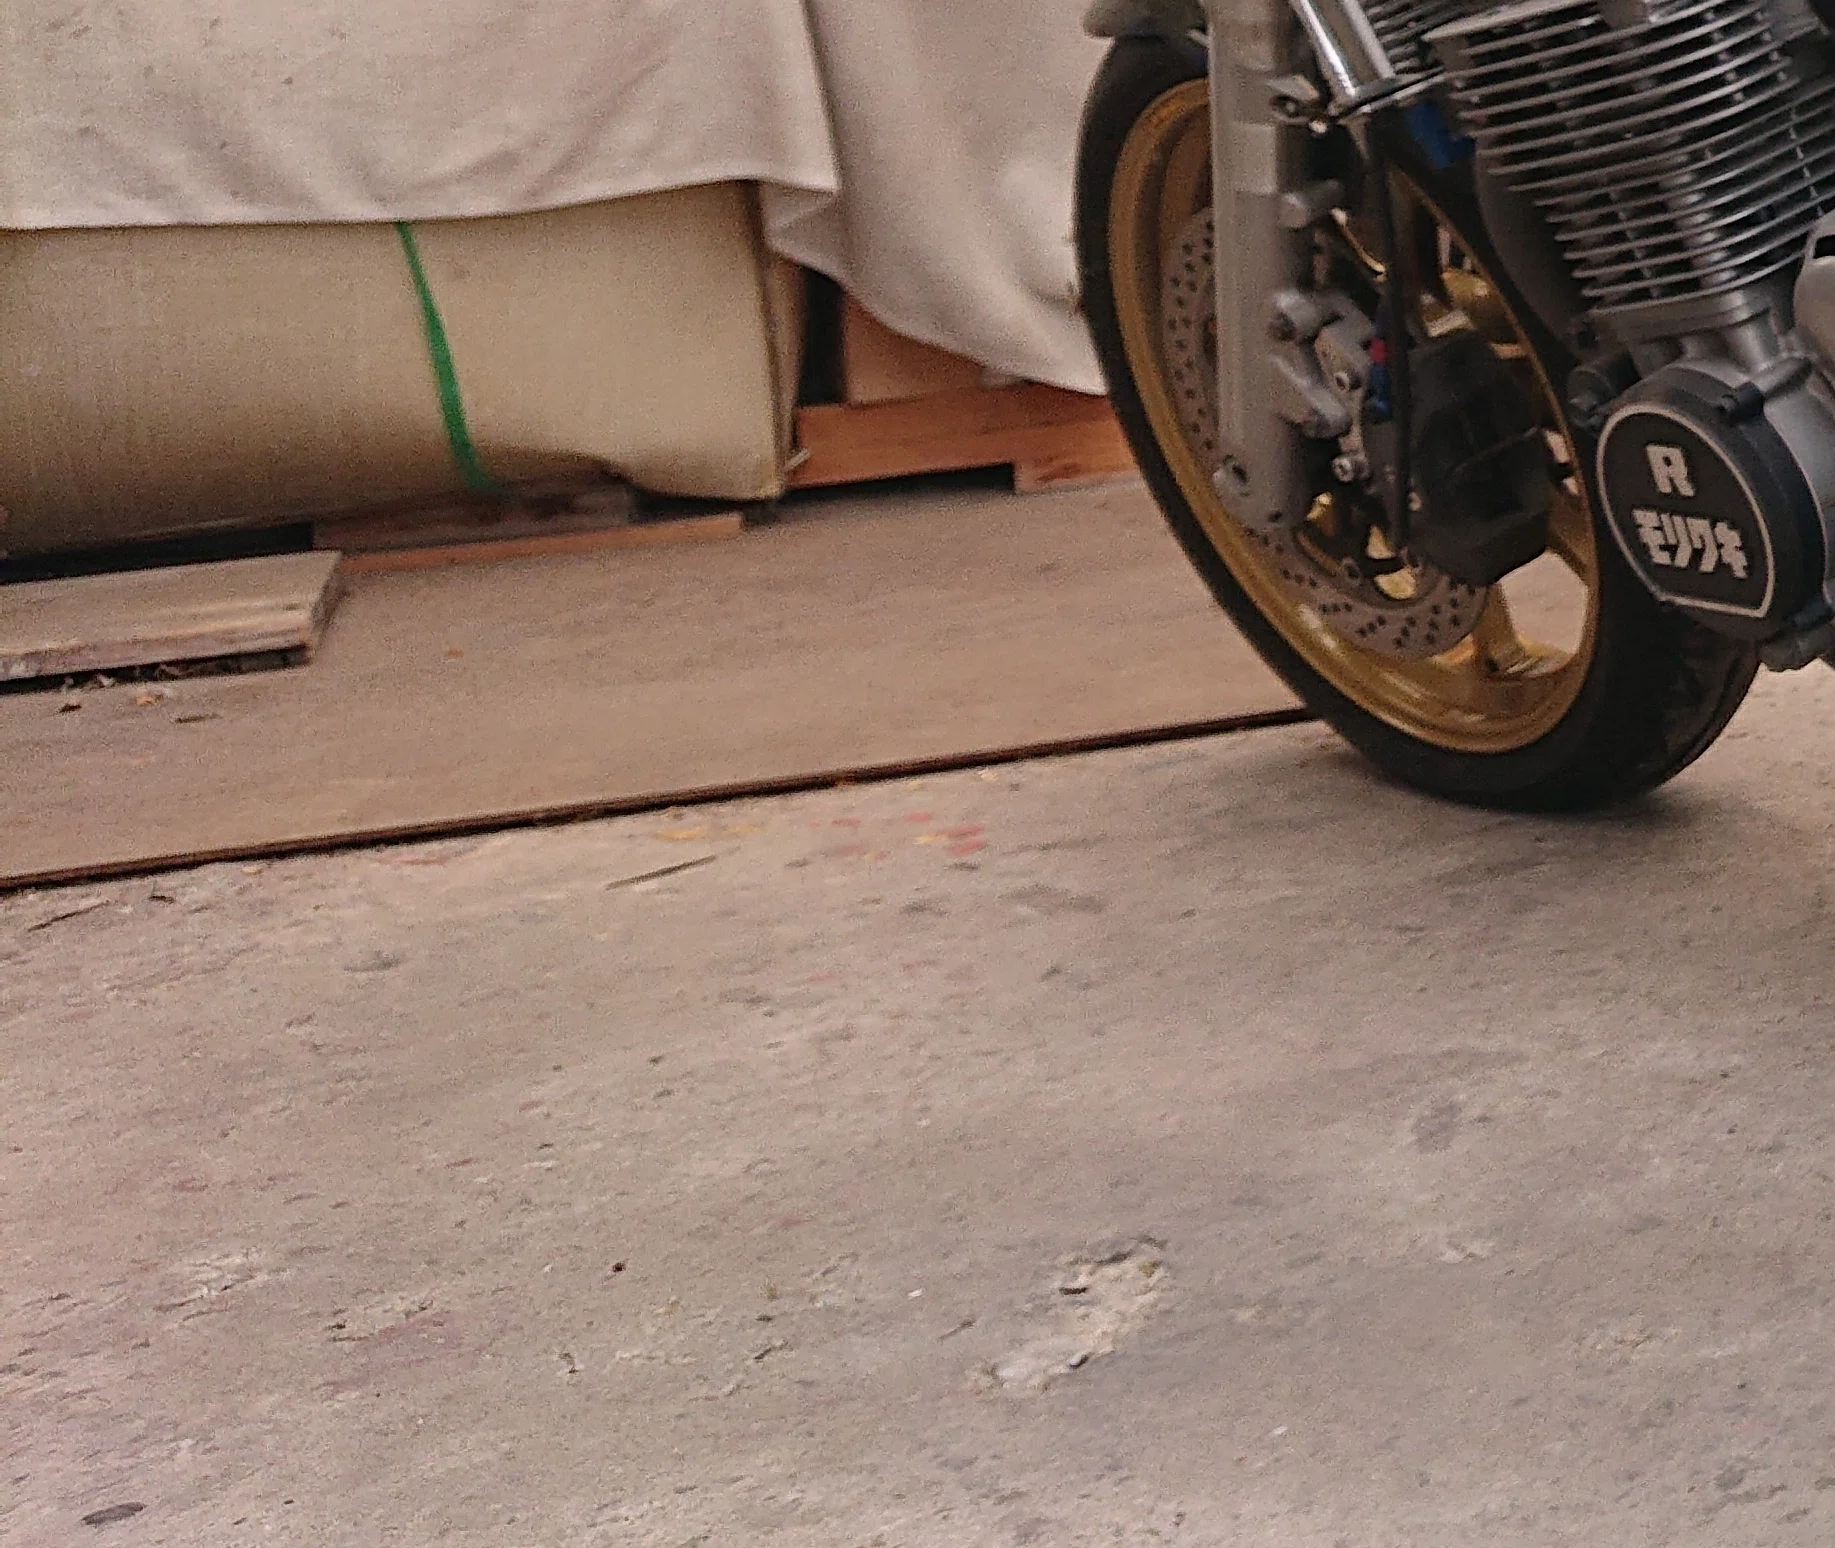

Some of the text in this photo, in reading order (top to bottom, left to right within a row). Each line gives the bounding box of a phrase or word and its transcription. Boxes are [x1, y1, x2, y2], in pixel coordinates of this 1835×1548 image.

[1645, 444, 1695, 497] R
[1631, 509, 1748, 580] モリワキ
